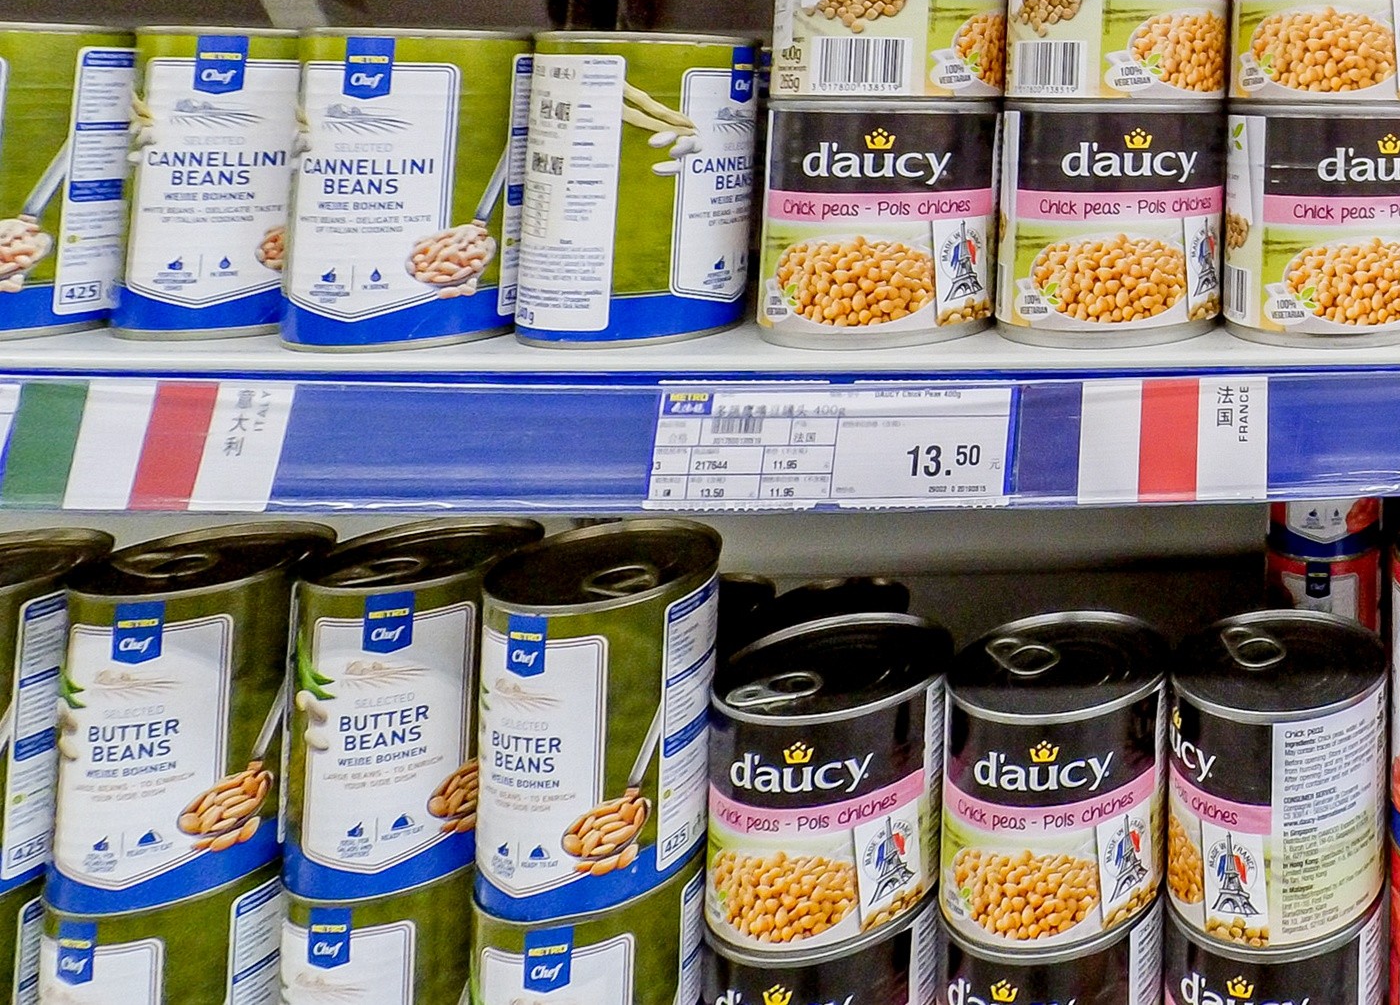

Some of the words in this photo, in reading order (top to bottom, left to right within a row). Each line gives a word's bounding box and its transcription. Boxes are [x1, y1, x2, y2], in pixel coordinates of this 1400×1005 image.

[148, 150, 287, 168] CANNELLINI
[303, 157, 435, 176] CANNELLINI
[171, 170, 251, 186] BEANS
[323, 178, 399, 195] BEANS
[783, 198, 816, 215] Chick
[820, 202, 859, 220] peas
[918, 198, 971, 214] chiches
[1039, 198, 1077, 215] Chick
[1081, 201, 1121, 220] peas
[1173, 196, 1213, 213] chiches
[1293, 203, 1334, 220] Chick
[1339, 205, 1376, 223] peas
[64, 285, 98, 300] 425
[1216, 386, 1234, 427] 法国
[1238, 385, 1250, 443] FRANCE
[223, 388, 254, 457] 意大利
[793, 432, 816, 443] 法国
[772, 460, 797, 470] 11.95
[907, 445, 981, 477] 13.50
[700, 488, 724, 497] 13.50
[770, 488, 794, 497] 11.95
[119, 634, 155, 653] Chef
[370, 624, 406, 643] Chef
[511, 648, 538, 667] Chef
[339, 705, 430, 733] BUTTER
[88, 718, 180, 743] BUTTER
[343, 726, 423, 752] BEANS
[91, 739, 171, 763] BEANS
[491, 730, 563, 755] BUTTER
[375, 745, 428, 765] BOHNEN
[494, 751, 556, 774] BEANS
[121, 760, 177, 776] BOHNEN
[515, 778, 561, 789] BOHNEN
[746, 815, 780, 833] peas
[838, 792, 898, 825] chiches
[957, 799, 988, 829] Chick
[992, 814, 1027, 831] peas
[1081, 790, 1135, 824] chiches
[1191, 797, 1239, 827] chiches
[665, 832, 688, 853] 425
[312, 941, 343, 958] Chef
[530, 962, 563, 981] Chef
